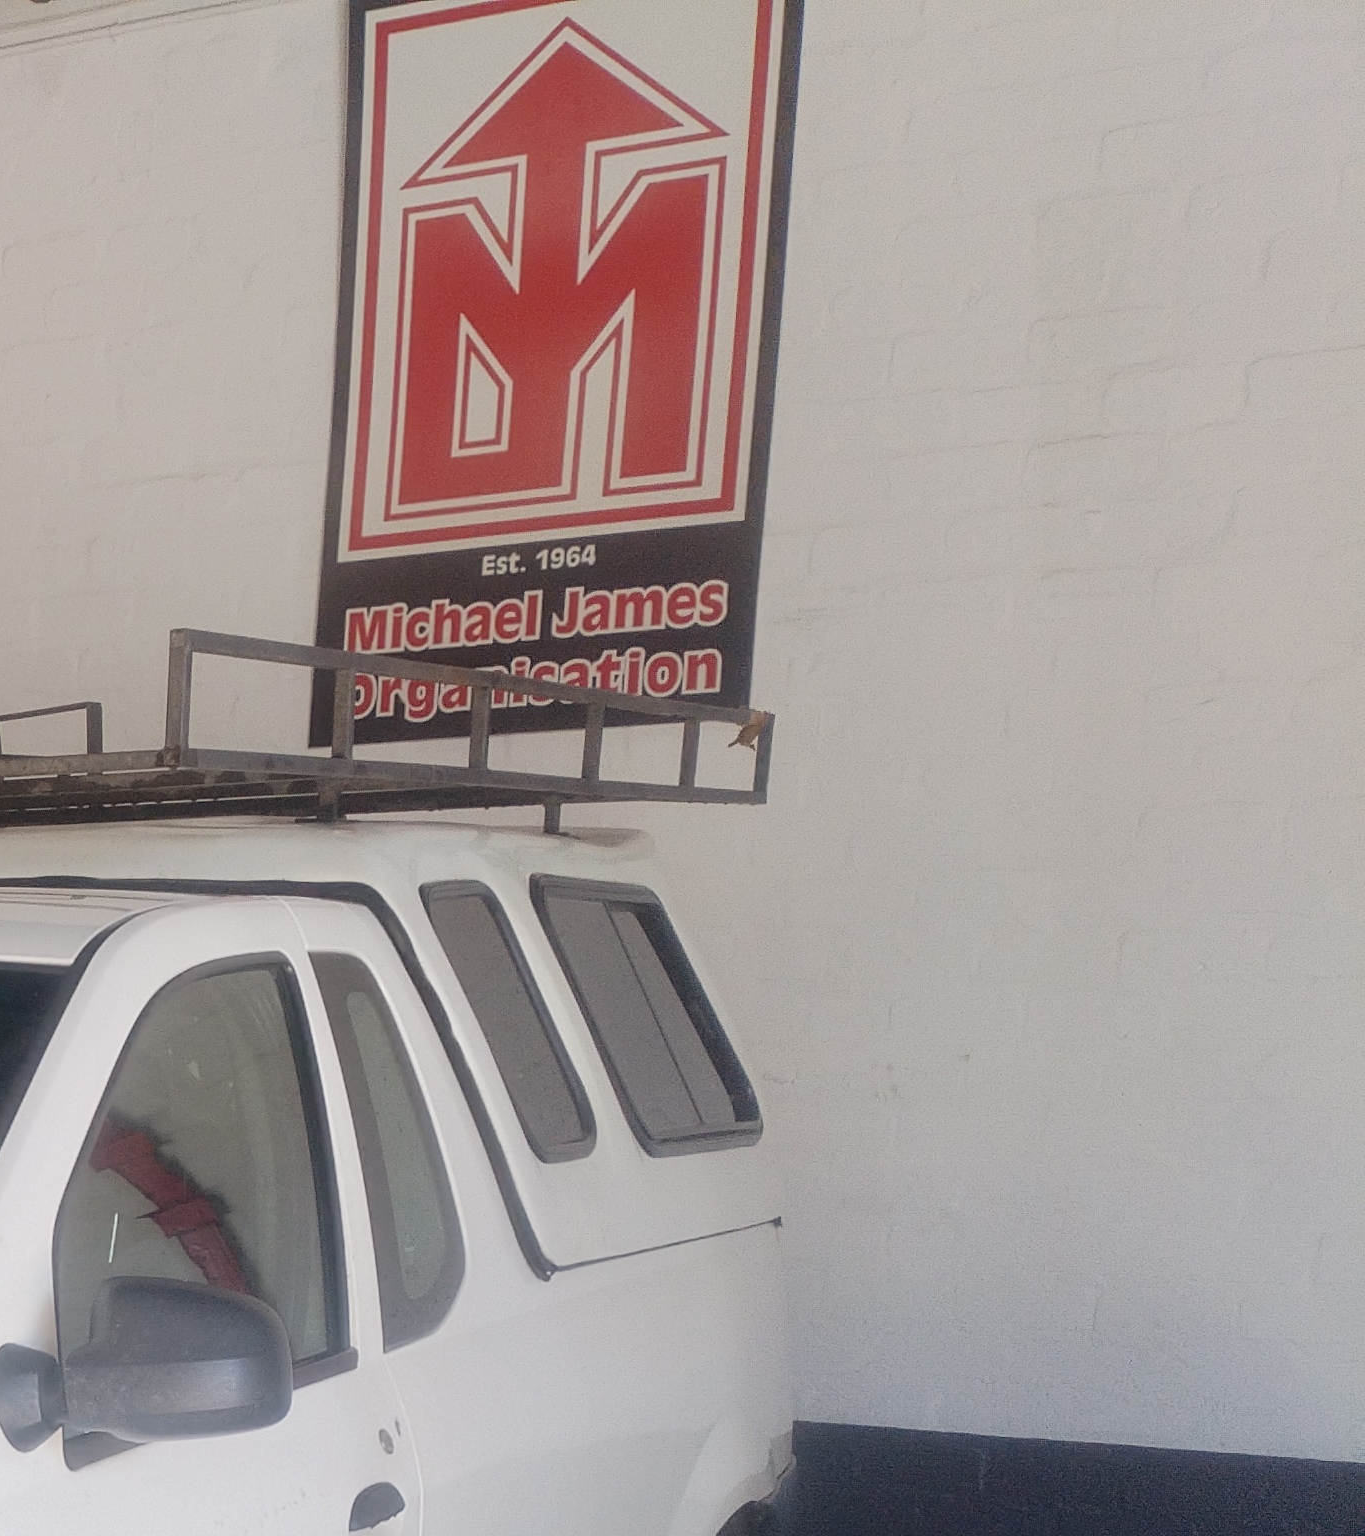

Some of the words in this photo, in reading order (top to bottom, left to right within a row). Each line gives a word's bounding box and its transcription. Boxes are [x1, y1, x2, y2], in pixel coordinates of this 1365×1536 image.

[481, 554, 527, 577] Est.
[536, 543, 597, 572] 1964
[344, 590, 543, 654] Michael
[551, 579, 729, 639] James
